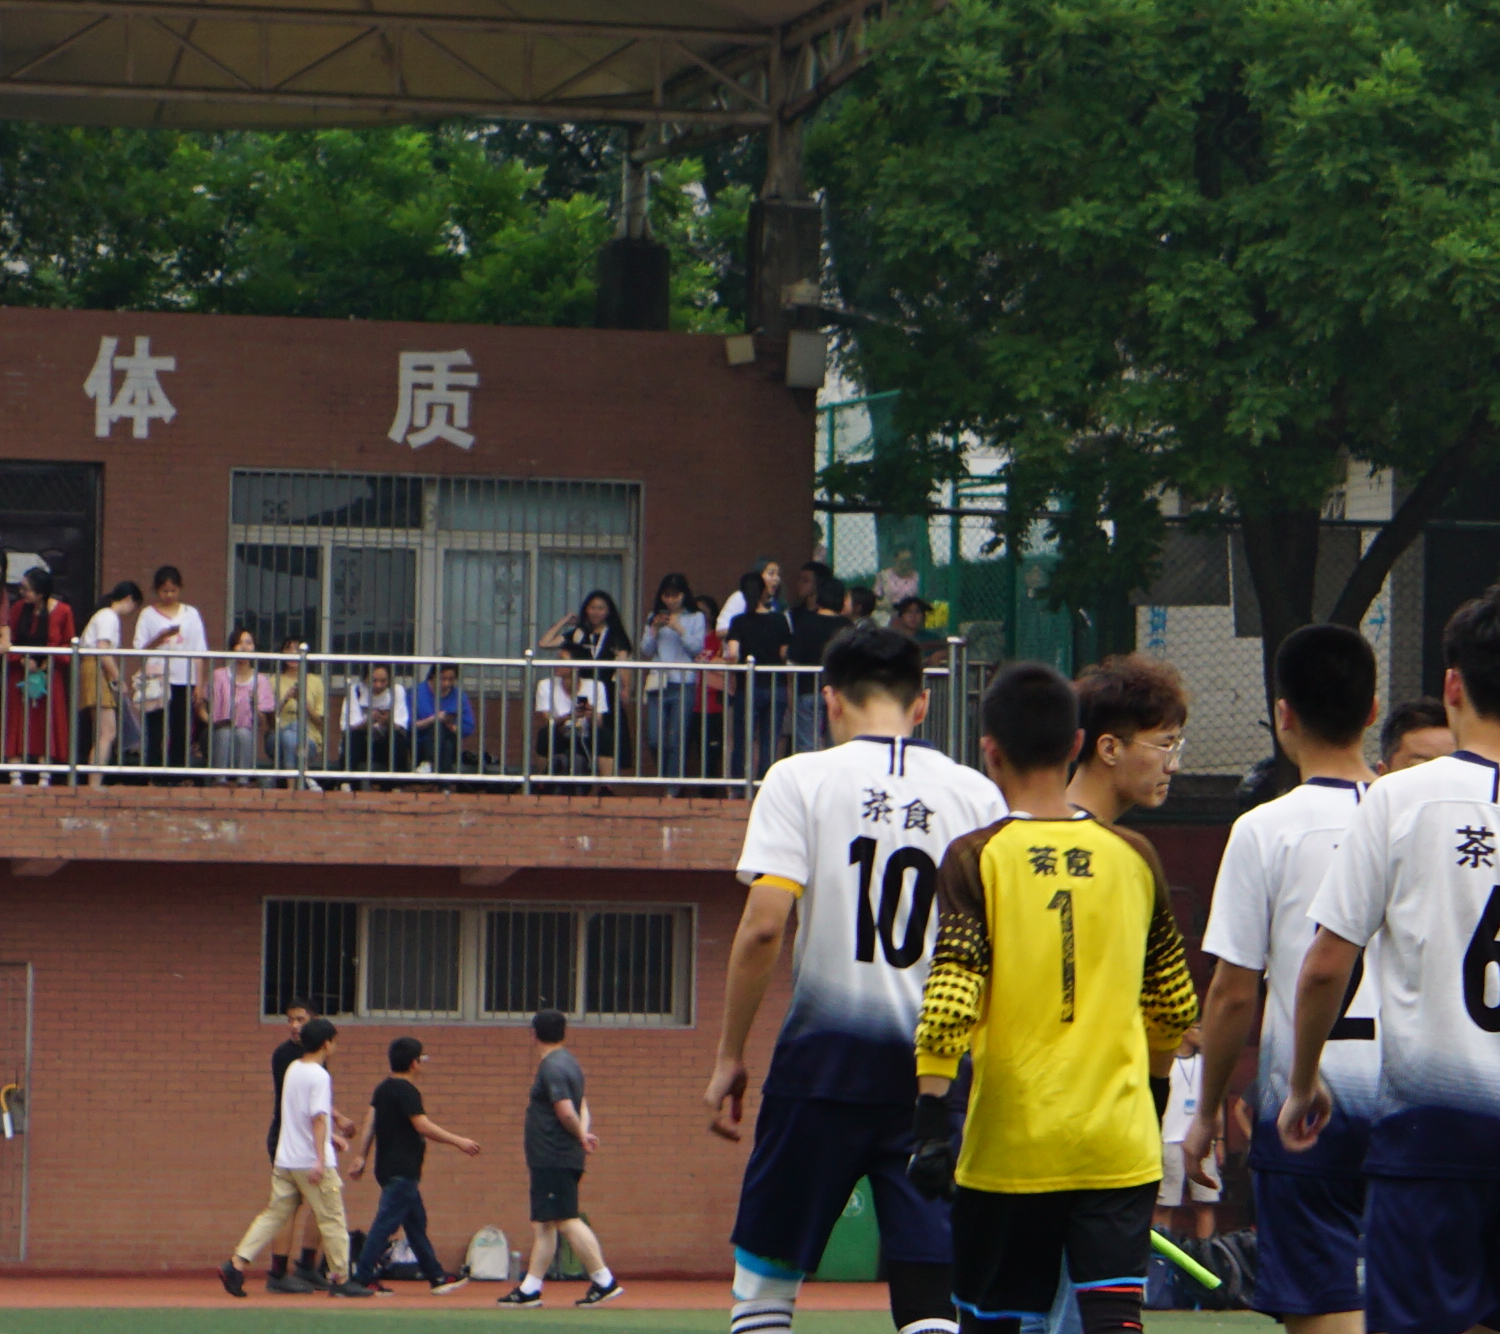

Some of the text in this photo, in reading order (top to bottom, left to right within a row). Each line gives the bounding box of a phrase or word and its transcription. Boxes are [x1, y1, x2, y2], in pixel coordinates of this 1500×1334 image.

[861, 789, 936, 835] 茶食
[848, 835, 938, 970] 10
[1028, 847, 1094, 879] 茶食
[1046, 889, 1076, 1024] 1
